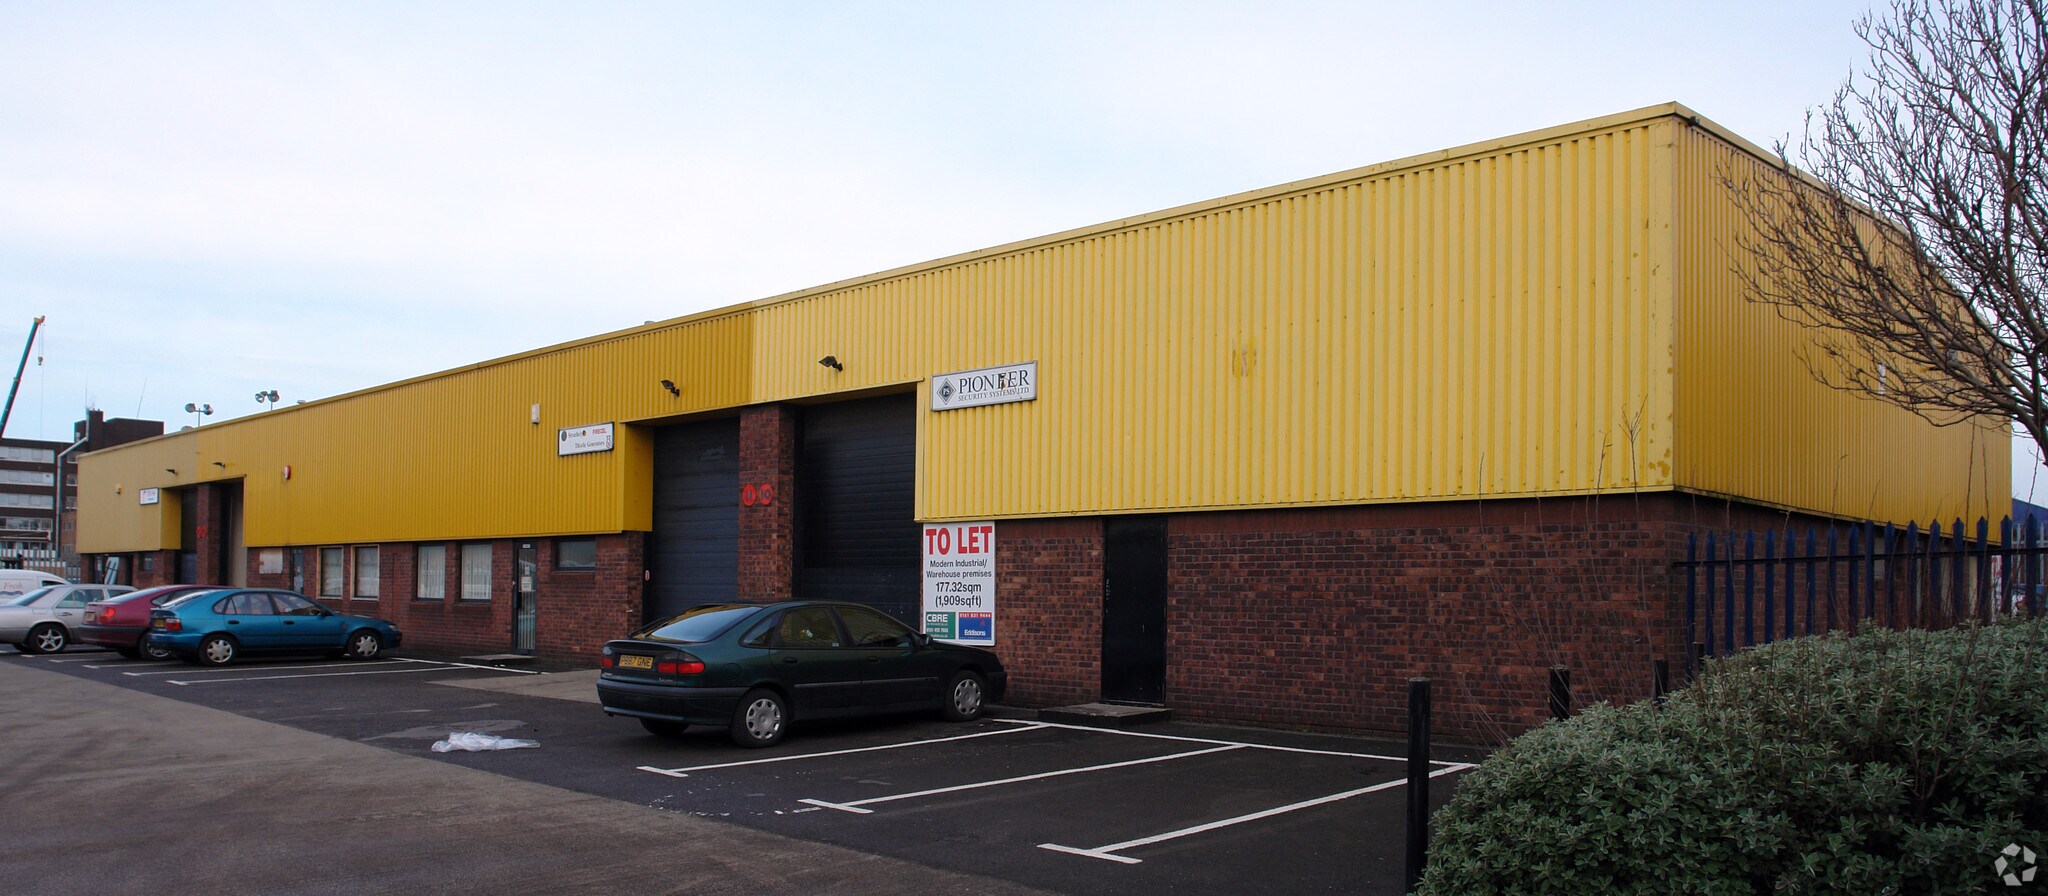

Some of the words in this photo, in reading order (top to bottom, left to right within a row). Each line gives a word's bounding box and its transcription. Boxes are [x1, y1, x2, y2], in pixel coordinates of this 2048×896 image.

[958, 392, 988, 402] SECURITY
[989, 389, 1015, 398] SYSTEMS
[925, 527, 951, 555] TO
[957, 525, 993, 554] LET
[930, 560, 953, 568] Modern
[955, 559, 987, 568] Industrial/
[926, 570, 960, 579] Warehouse
[962, 570, 992, 579] premises
[936, 582, 982, 594] 177.32sqm
[935, 595, 982, 608] (1,909sqft)
[926, 614, 948, 623] CBRE
